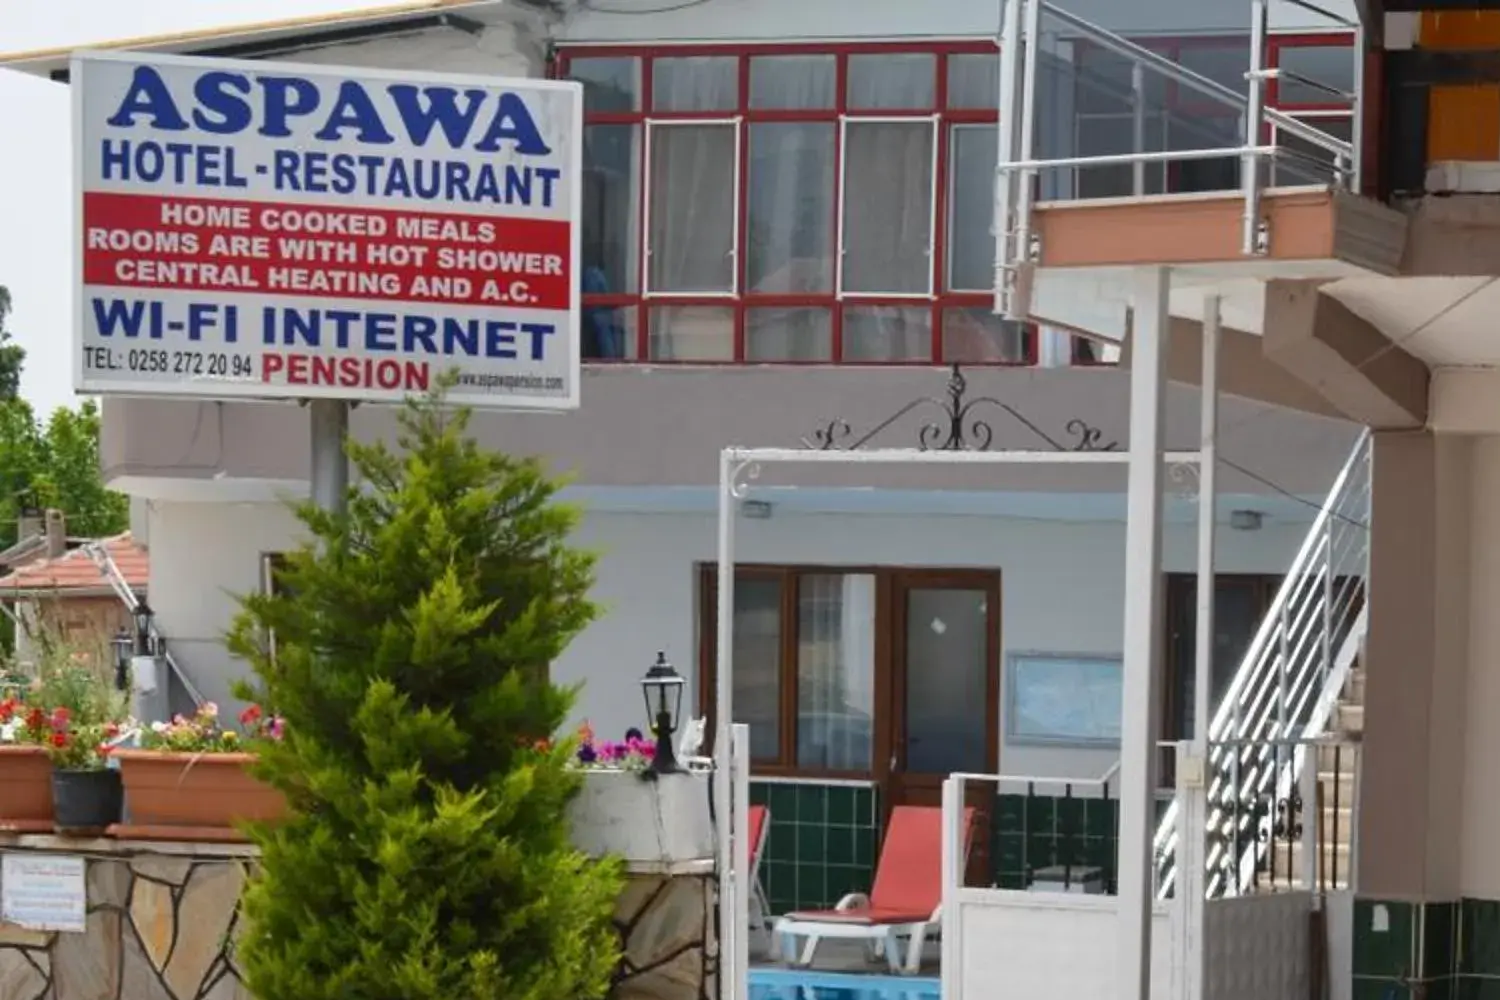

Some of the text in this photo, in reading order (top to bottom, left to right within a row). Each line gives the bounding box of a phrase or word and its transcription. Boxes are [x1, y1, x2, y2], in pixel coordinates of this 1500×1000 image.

[107, 65, 551, 155] ASPAWA
[161, 203, 496, 243] HOME COOKED MEALS
[88, 228, 563, 275] ROOMS ARE WITH HOT SHOWER
[115, 259, 538, 302] CENTRAL HEATING AND A.C.
[92, 298, 555, 361] WI-FI INTERNET
[84, 347, 252, 377] TEL: 0258 272 20 94
[262, 354, 429, 391] PENSION
